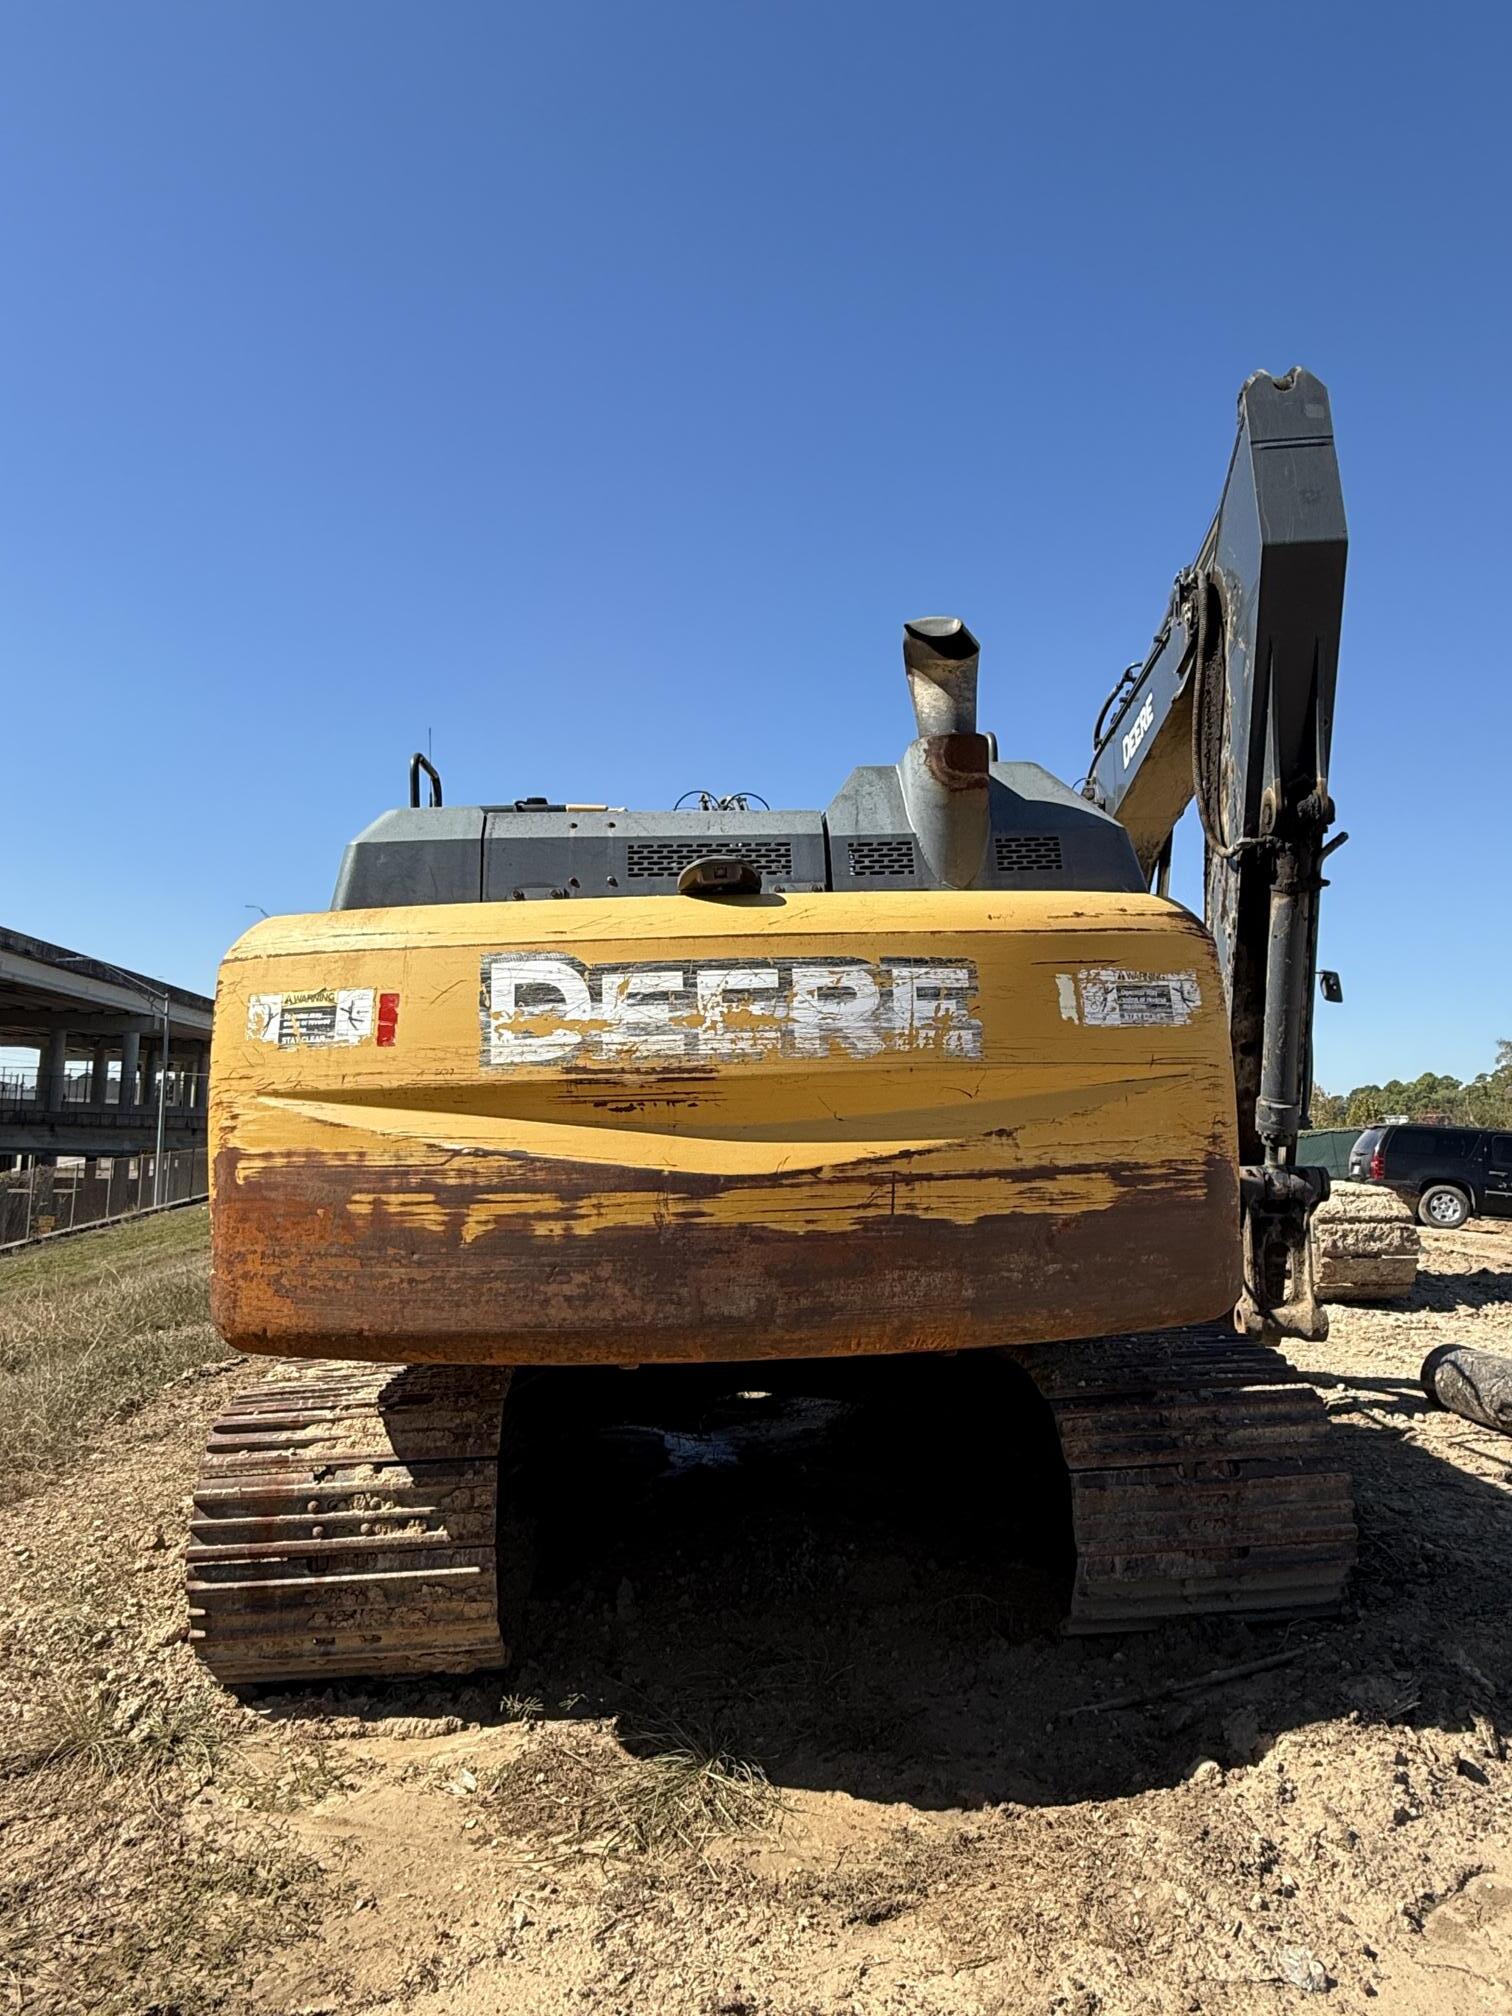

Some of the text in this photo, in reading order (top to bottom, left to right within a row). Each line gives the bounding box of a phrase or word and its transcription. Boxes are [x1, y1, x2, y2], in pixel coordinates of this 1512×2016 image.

[1122, 692, 1154, 770] DEERE
[293, 992, 335, 1004] WARNING
[490, 960, 984, 1064] DEERE
